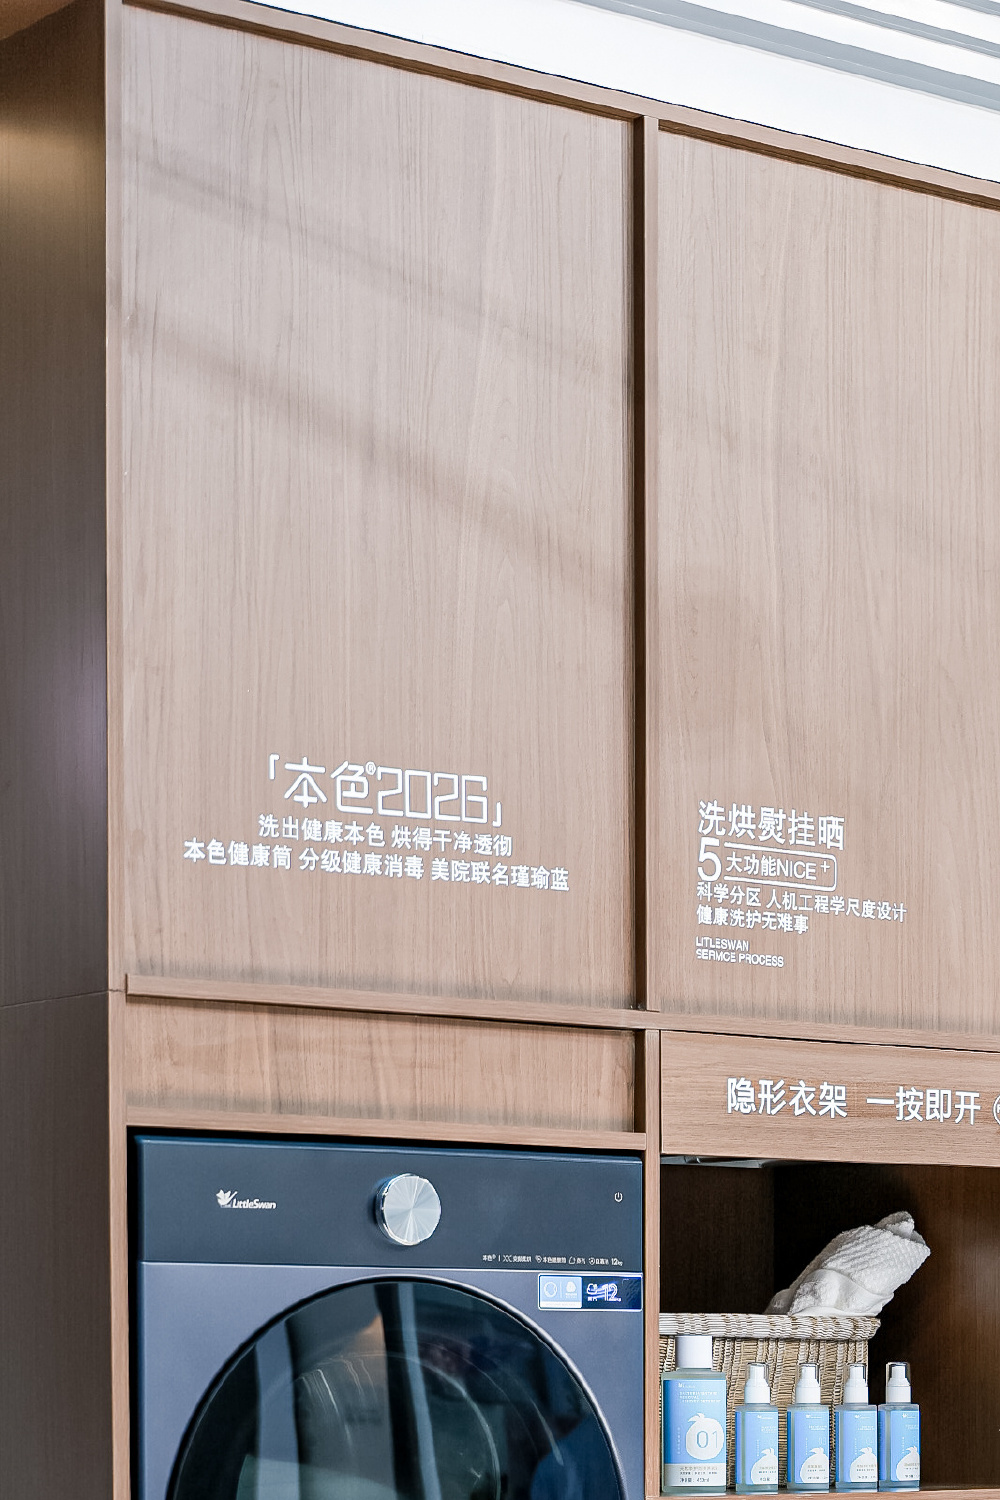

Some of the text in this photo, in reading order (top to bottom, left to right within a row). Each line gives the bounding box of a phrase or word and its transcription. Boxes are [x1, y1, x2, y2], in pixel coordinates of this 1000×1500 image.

[258, 814, 513, 858] 洗出健康本色 烘得干净透彻
[698, 800, 845, 850] 洗烘熨挂晒
[183, 837, 570, 892] 本色健康筒 分级健康消毒 美院联名瑾瑜蓝
[698, 837, 722, 881] 5
[697, 882, 907, 923] 科学分区 人机工程学尺度设计
[697, 904, 809, 934] 健康洗护无难事
[738, 953, 784, 968] PROCESS
[726, 1077, 981, 1125] 隐形衣架 一按即开
[697, 1431, 718, 1449] 01
